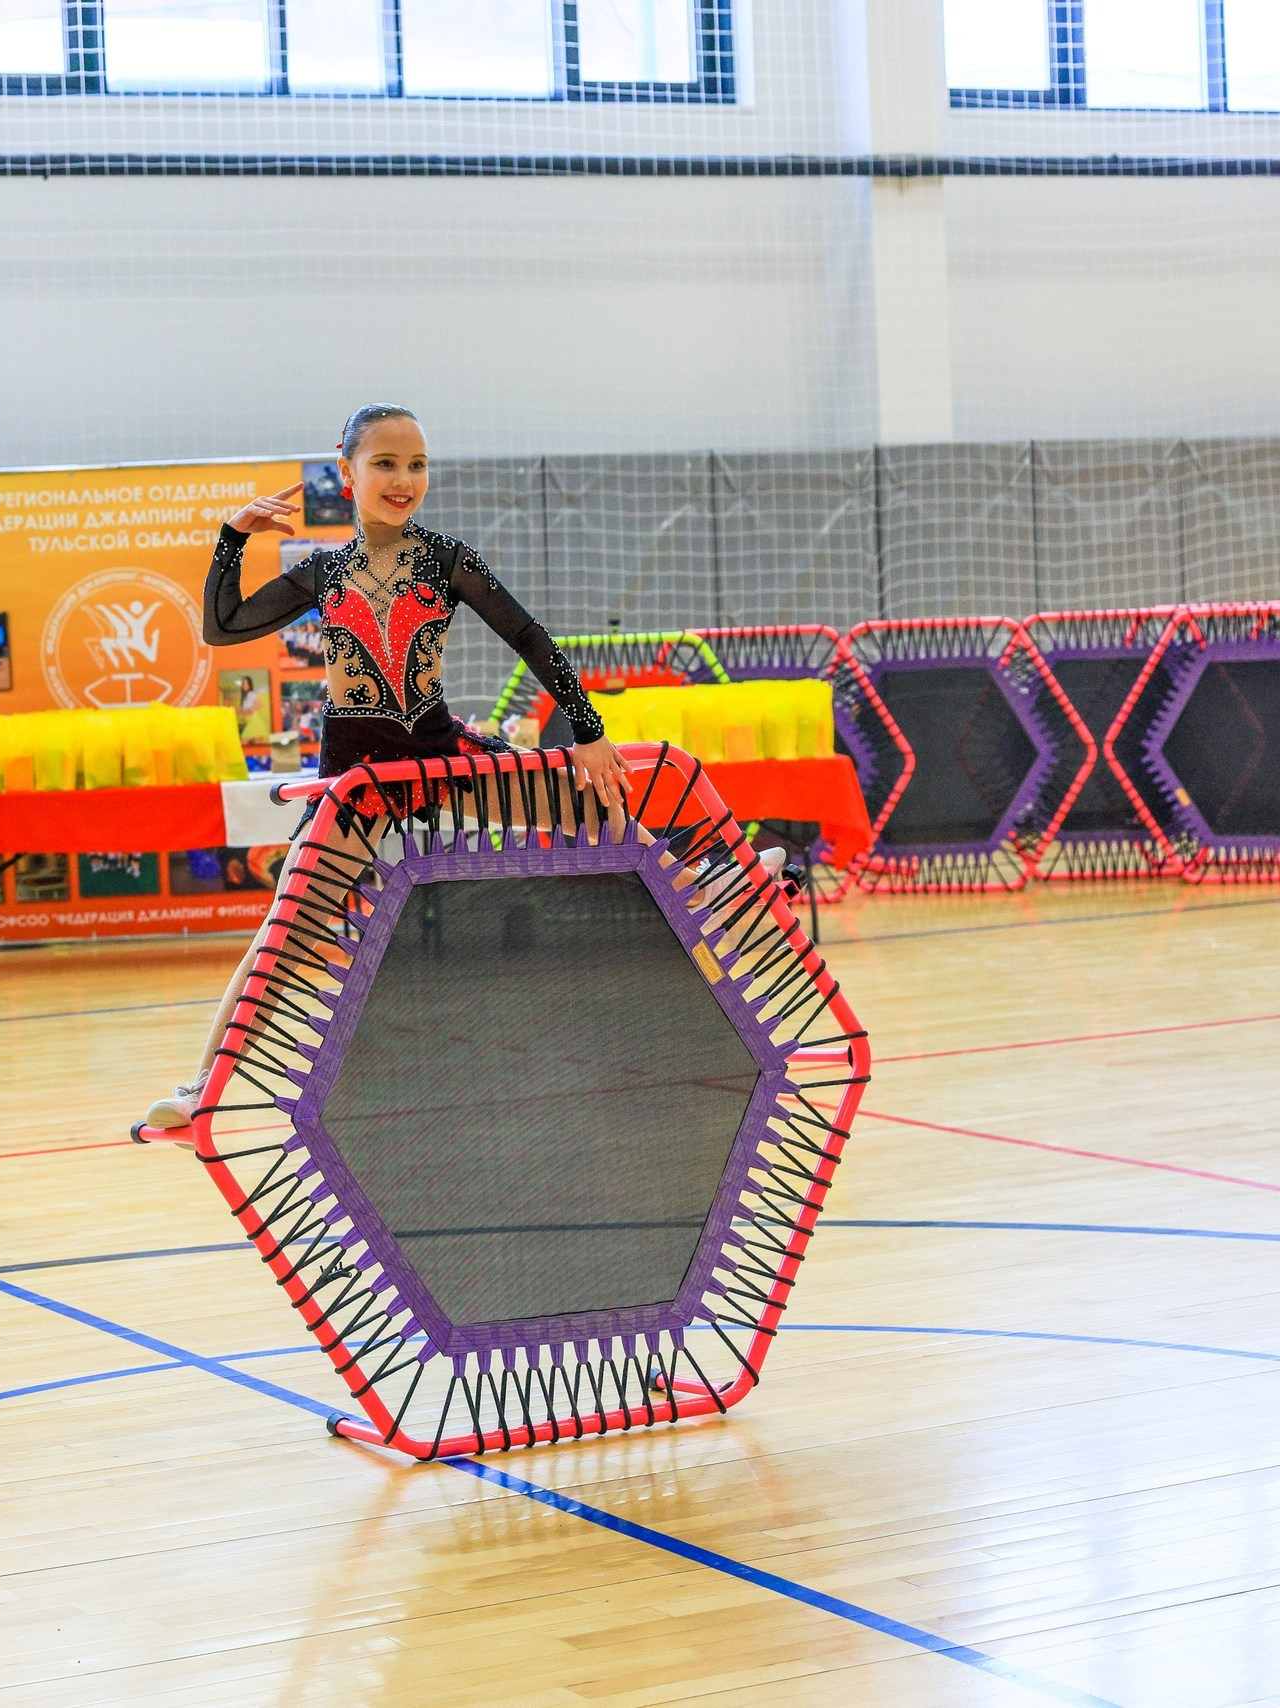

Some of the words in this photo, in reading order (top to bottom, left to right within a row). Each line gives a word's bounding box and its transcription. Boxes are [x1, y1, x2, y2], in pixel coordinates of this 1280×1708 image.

[148, 481, 257, 502] ОТДЕЛЕНИЕ
[83, 508, 195, 529] ДЖАМПИНГ
[29, 529, 130, 553] ТУЛЬСКОЙ
[217, 902, 269, 918] ФИТНЕС
